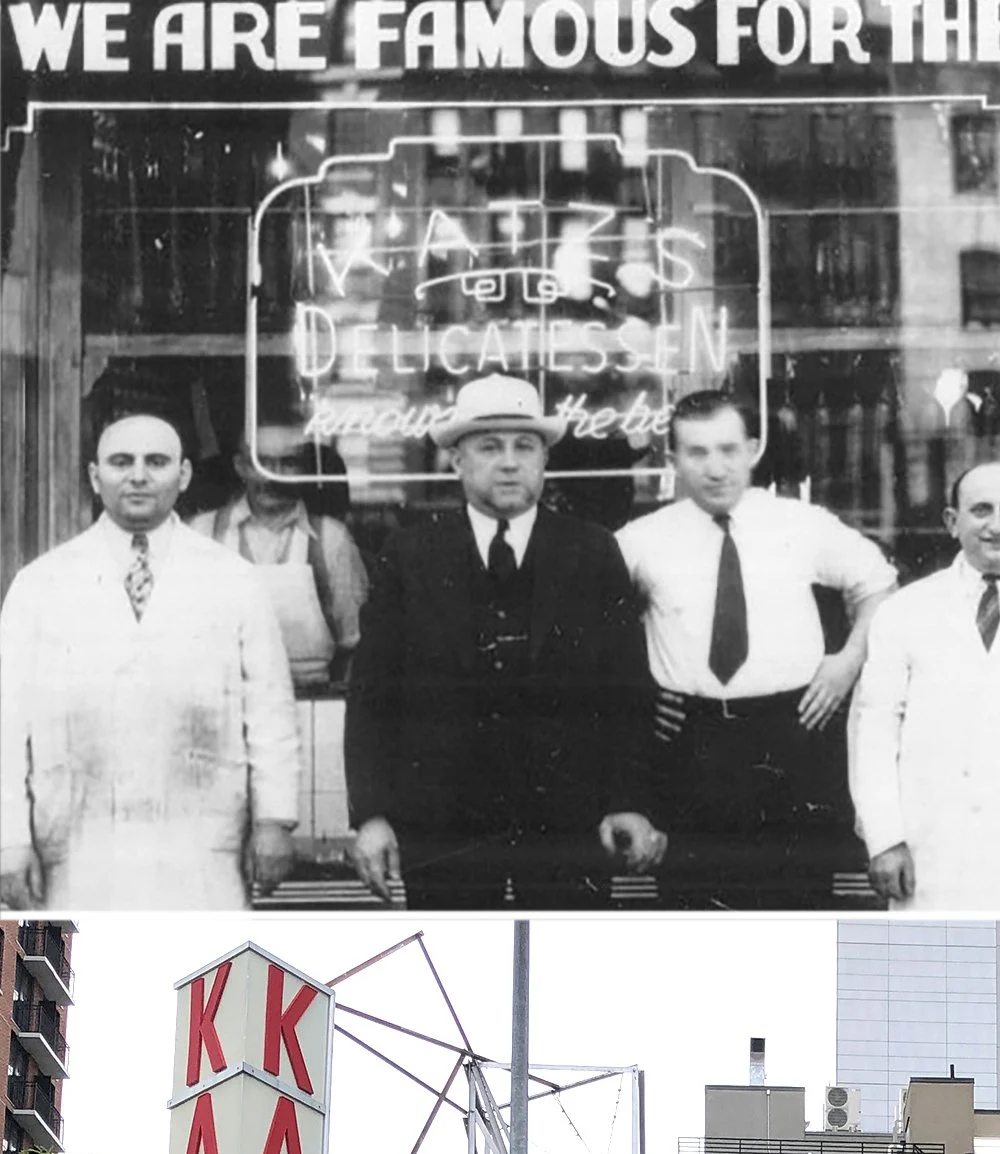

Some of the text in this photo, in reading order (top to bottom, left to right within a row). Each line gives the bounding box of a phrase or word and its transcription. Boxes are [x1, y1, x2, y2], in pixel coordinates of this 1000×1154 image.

[8, 2, 130, 71] WE
[153, 1, 326, 71] ARE
[355, 0, 696, 69] FAMOUS
[716, 0, 870, 66] FOR
[296, 303, 728, 377] DELICATESSEN
[555, 391, 616, 439] the
[620, 389, 676, 435] be
